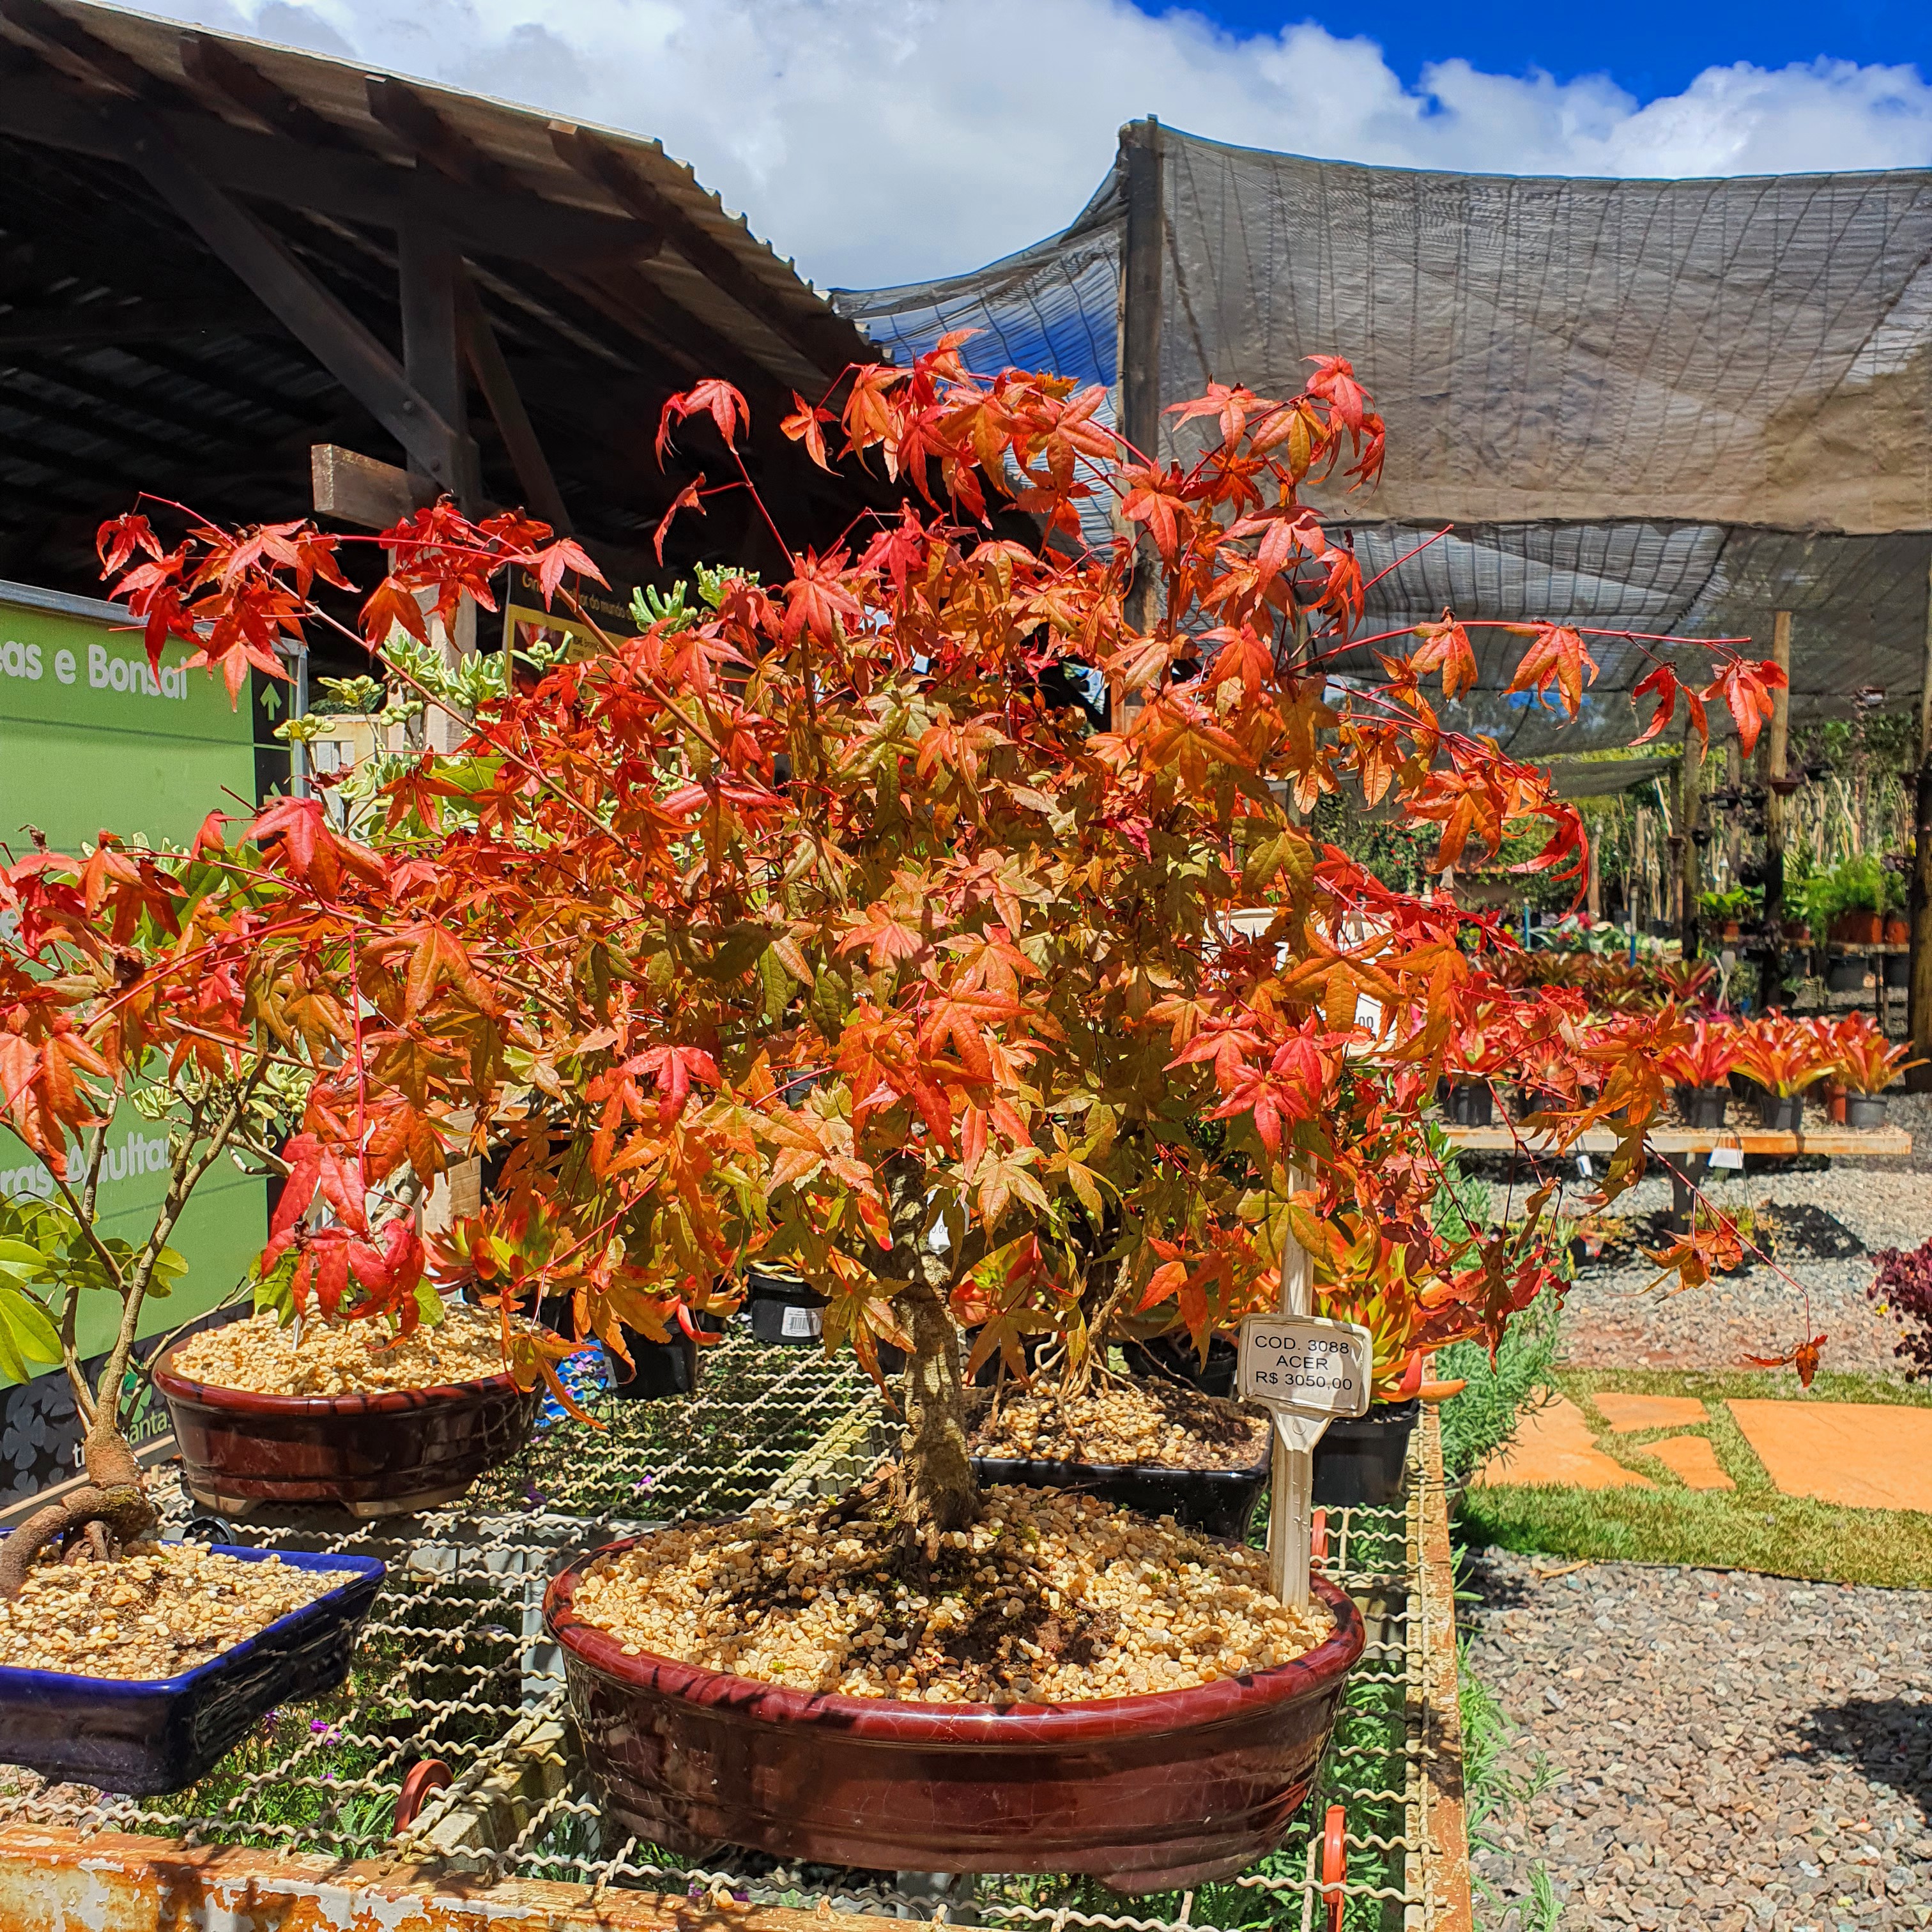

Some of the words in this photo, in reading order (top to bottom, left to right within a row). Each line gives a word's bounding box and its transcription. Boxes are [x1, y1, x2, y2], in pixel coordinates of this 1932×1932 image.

[0, 641, 43, 680] as
[55, 649, 76, 684] e
[88, 644, 188, 700] Bonsai
[1255, 1335, 1301, 1351] COD.
[1307, 1339, 1349, 1354] 3088
[1276, 1354, 1329, 1370] ACER
[1255, 1371, 1278, 1385] R$
[1284, 1373, 1353, 1390] 3050,00
